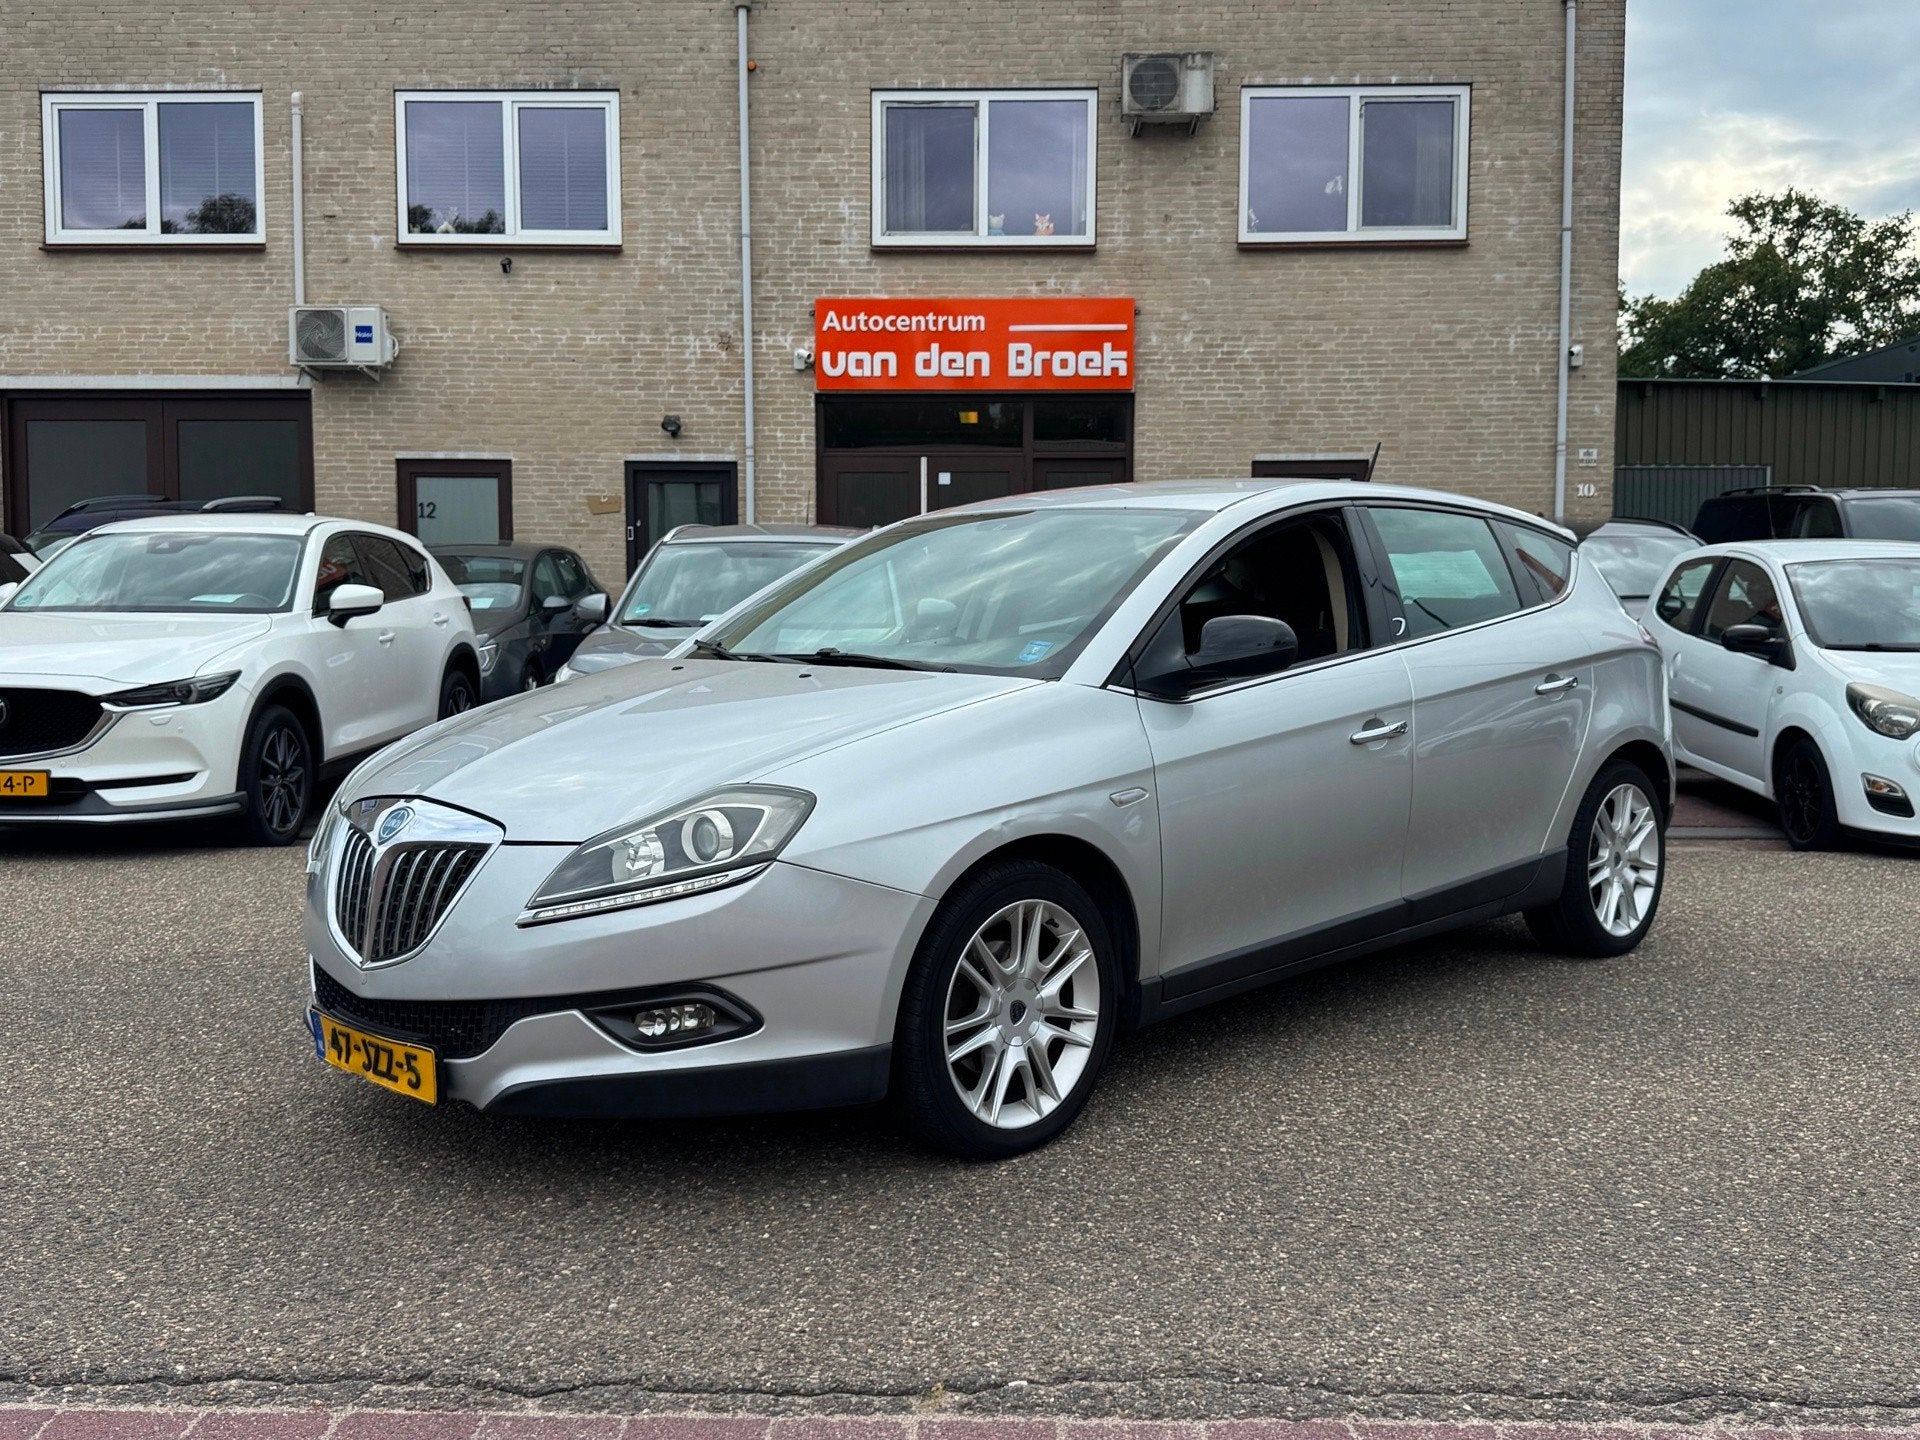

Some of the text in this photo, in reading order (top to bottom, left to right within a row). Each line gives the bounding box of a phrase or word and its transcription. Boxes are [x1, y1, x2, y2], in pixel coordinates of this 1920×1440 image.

[822, 310, 986, 332] Autocentrum
[821, 342, 1128, 377] van den Broek
[418, 501, 436, 519] 12
[1, 775, 35, 792] 4-P
